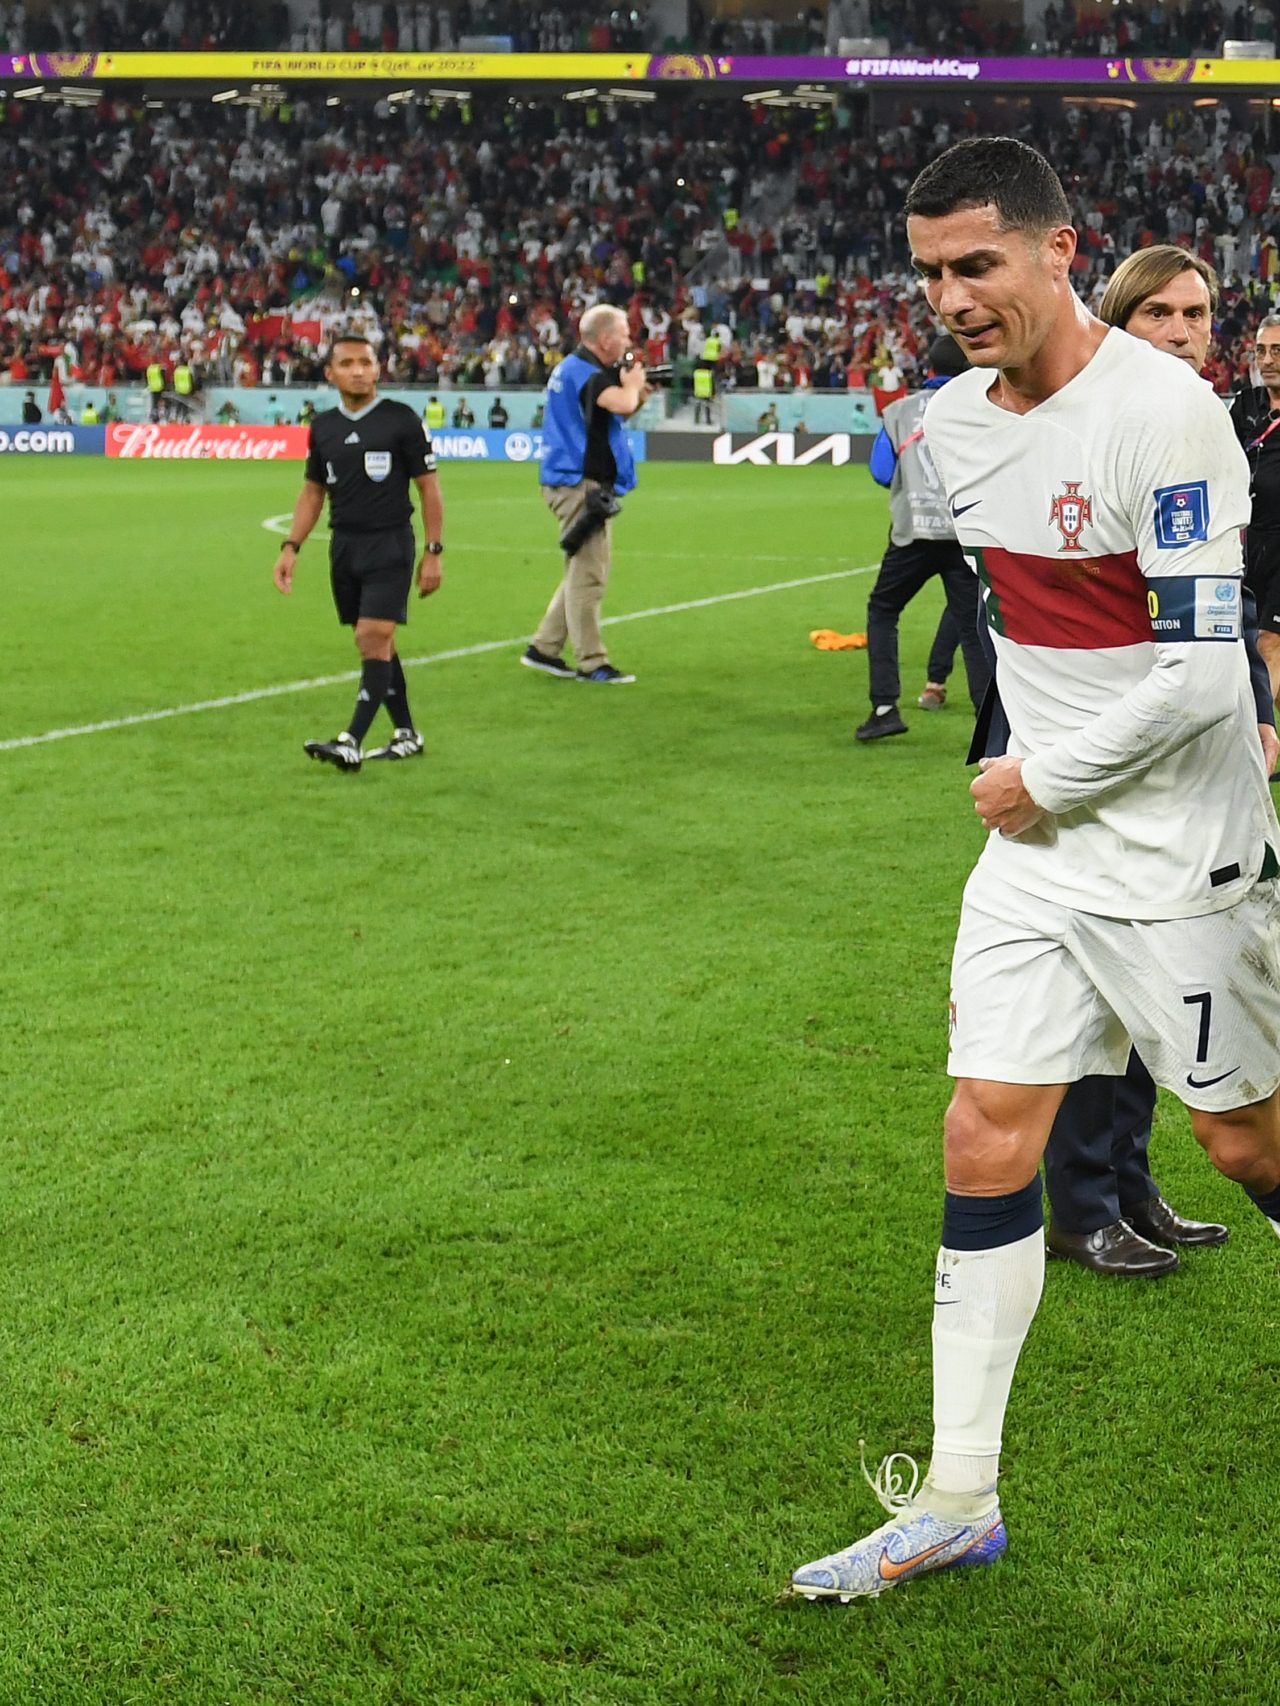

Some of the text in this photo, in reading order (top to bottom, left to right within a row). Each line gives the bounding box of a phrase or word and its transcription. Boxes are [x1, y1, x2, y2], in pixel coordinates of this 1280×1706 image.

[845, 59, 980, 80] #FIFAWorldCup
[113, 424, 287, 459] Budweiser
[1183, 991, 1212, 1062] 7
